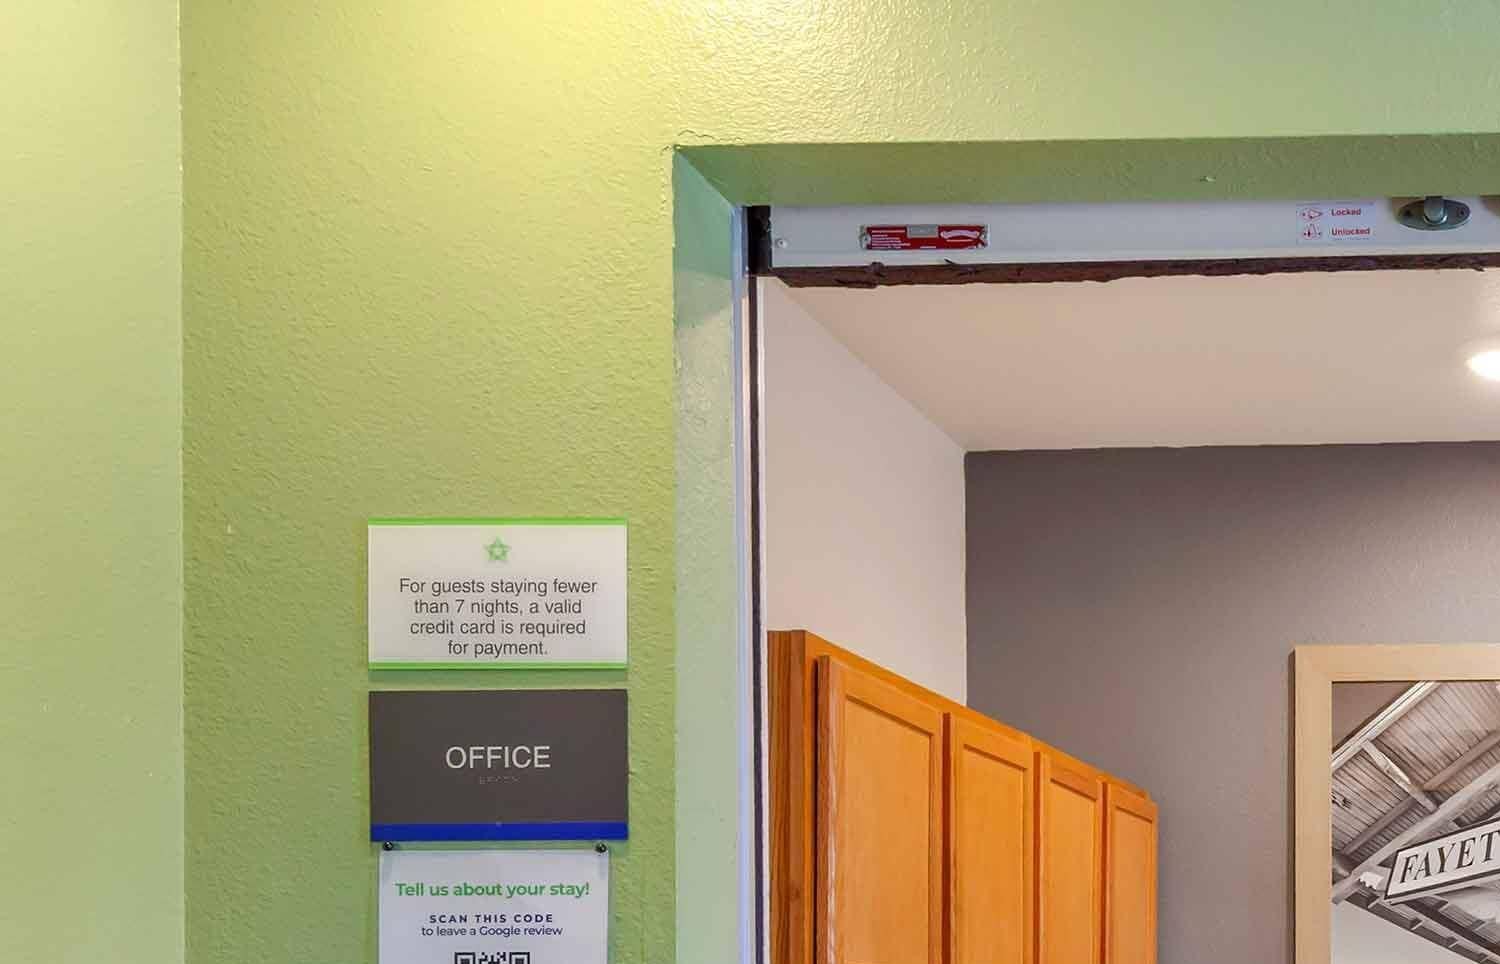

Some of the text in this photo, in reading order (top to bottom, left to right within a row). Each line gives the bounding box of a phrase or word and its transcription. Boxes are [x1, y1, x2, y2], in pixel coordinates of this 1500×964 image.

[1331, 208, 1361, 216] Locked
[1331, 226, 1370, 236] Unlocked
[399, 577, 598, 596] For guests staying fewer
[414, 599, 582, 617] than 7 nights, a valid
[410, 620, 587, 637] credit card is required
[447, 640, 549, 658] for payment.
[445, 746, 551, 769] OFFICE
[395, 882, 590, 899] Tell us about your stay!
[429, 913, 554, 924] SCAN THIS CODE
[421, 925, 564, 938] to leave a Google review
